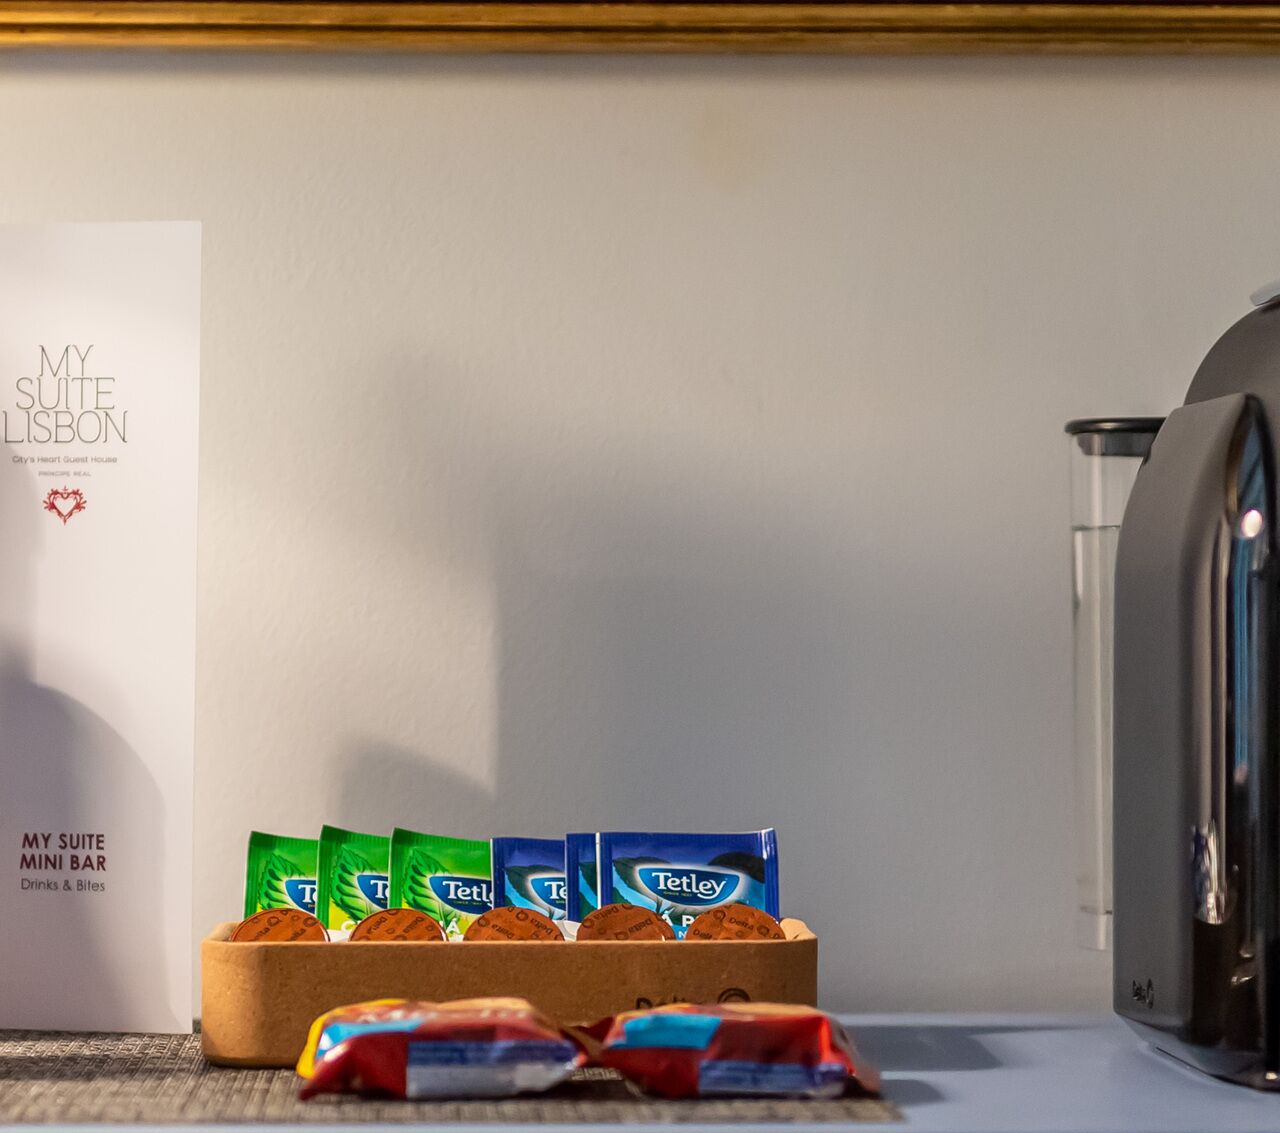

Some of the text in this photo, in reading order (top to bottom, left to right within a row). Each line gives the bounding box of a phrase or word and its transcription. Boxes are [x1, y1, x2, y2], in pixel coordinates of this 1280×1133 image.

[39, 344, 94, 378] MY
[16, 377, 116, 410] SUITE
[2, 410, 128, 444] LISBON
[37, 455, 61, 464] Heart
[91, 455, 118, 464] House
[22, 832, 105, 850] MY SUITE
[19, 853, 106, 871] MINI BAR
[21, 878, 105, 892] Drinks & Bites
[651, 872, 726, 900] Tetley
